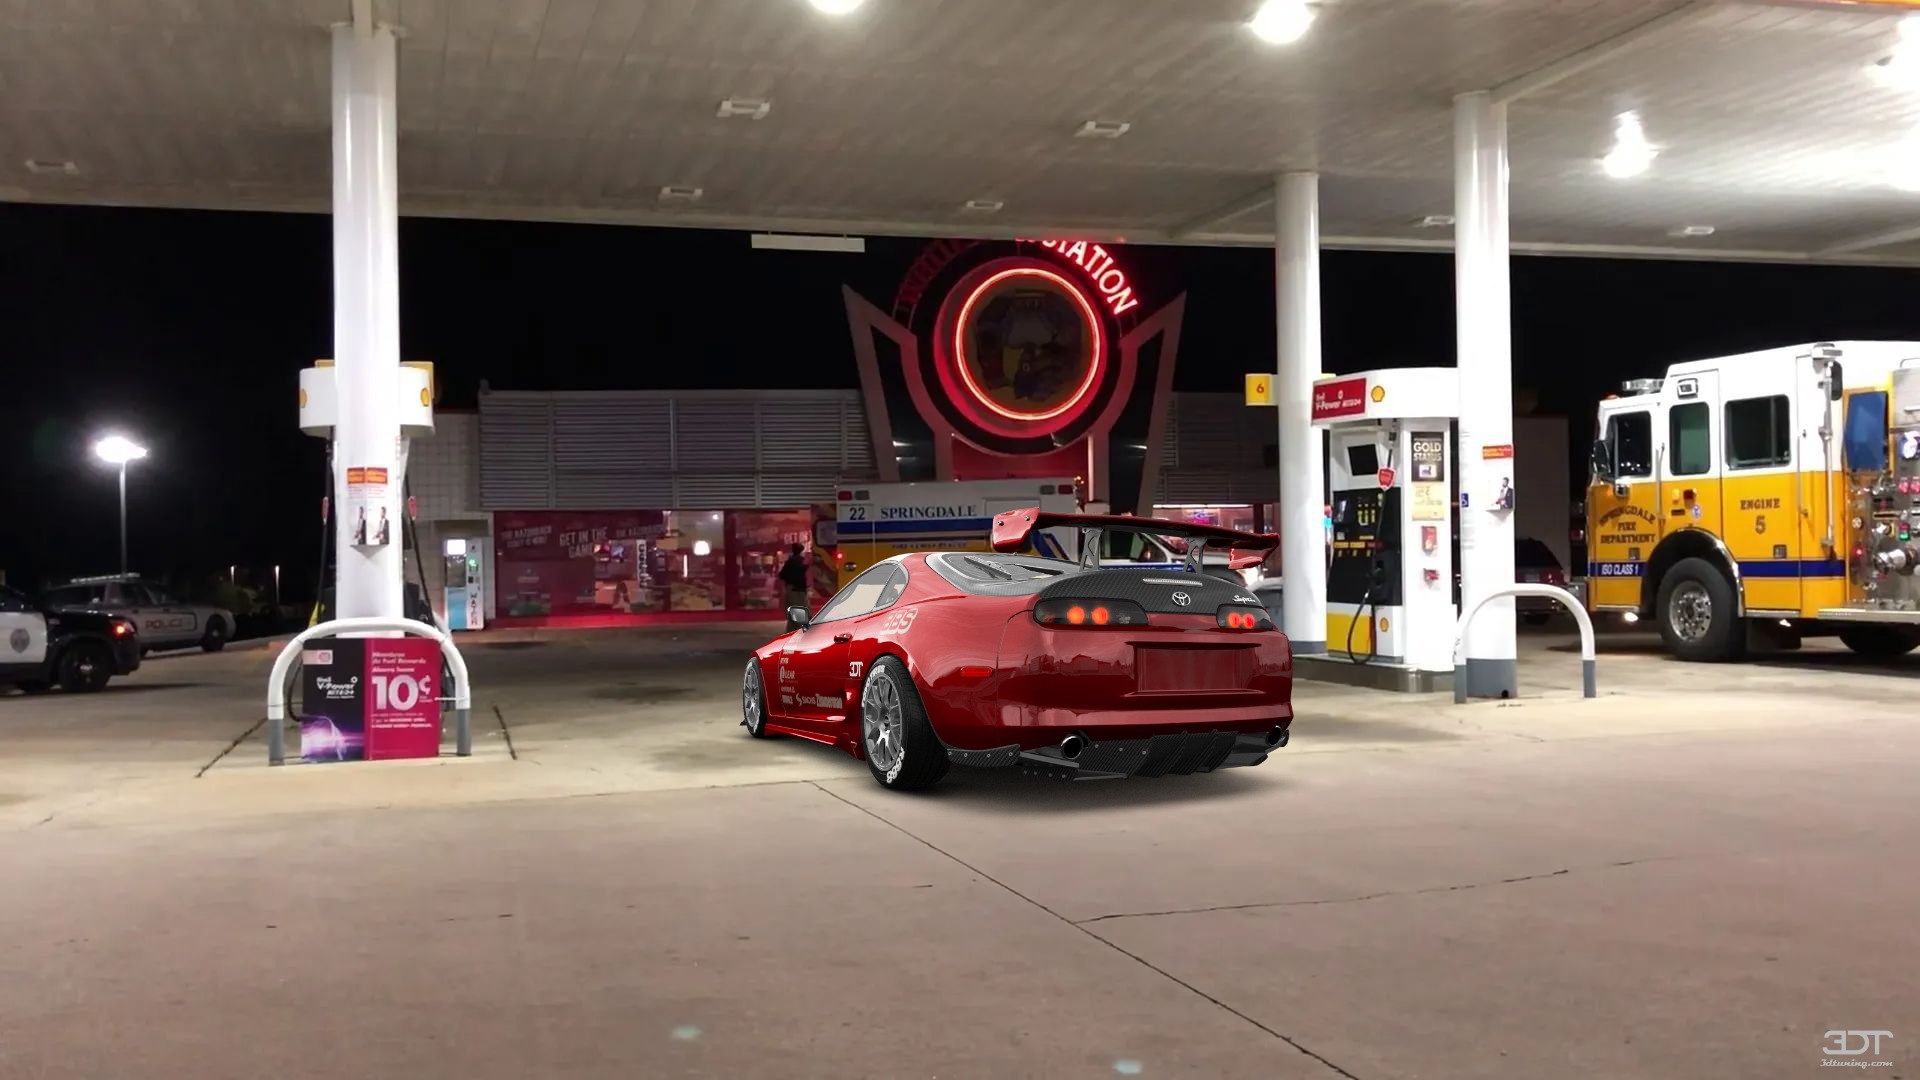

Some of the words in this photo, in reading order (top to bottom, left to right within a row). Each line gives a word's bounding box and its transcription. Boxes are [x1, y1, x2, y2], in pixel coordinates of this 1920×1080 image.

[1256, 383, 1265, 394] 6
[1413, 442, 1442, 453] GOLD
[1413, 452, 1442, 462] STATUS
[1740, 498, 1780, 510] ENGINE
[849, 507, 866, 521] 22
[880, 504, 977, 520] SPRINGDALE
[1600, 505, 1656, 526] SPRINGDALE
[1617, 521, 1637, 531] FIRE
[1755, 515, 1766, 534] 5
[559, 531, 577, 547] GET
[578, 529, 590, 545] IN
[592, 527, 608, 542] THE
[1600, 534, 1656, 544] DEPARTMENT
[1601, 564, 1613, 575] ISO
[1613, 564, 1634, 575] CLASS
[145, 618, 183, 629] POLICE
[879, 608, 919, 635] BBS
[317, 682, 355, 690] V-Power
